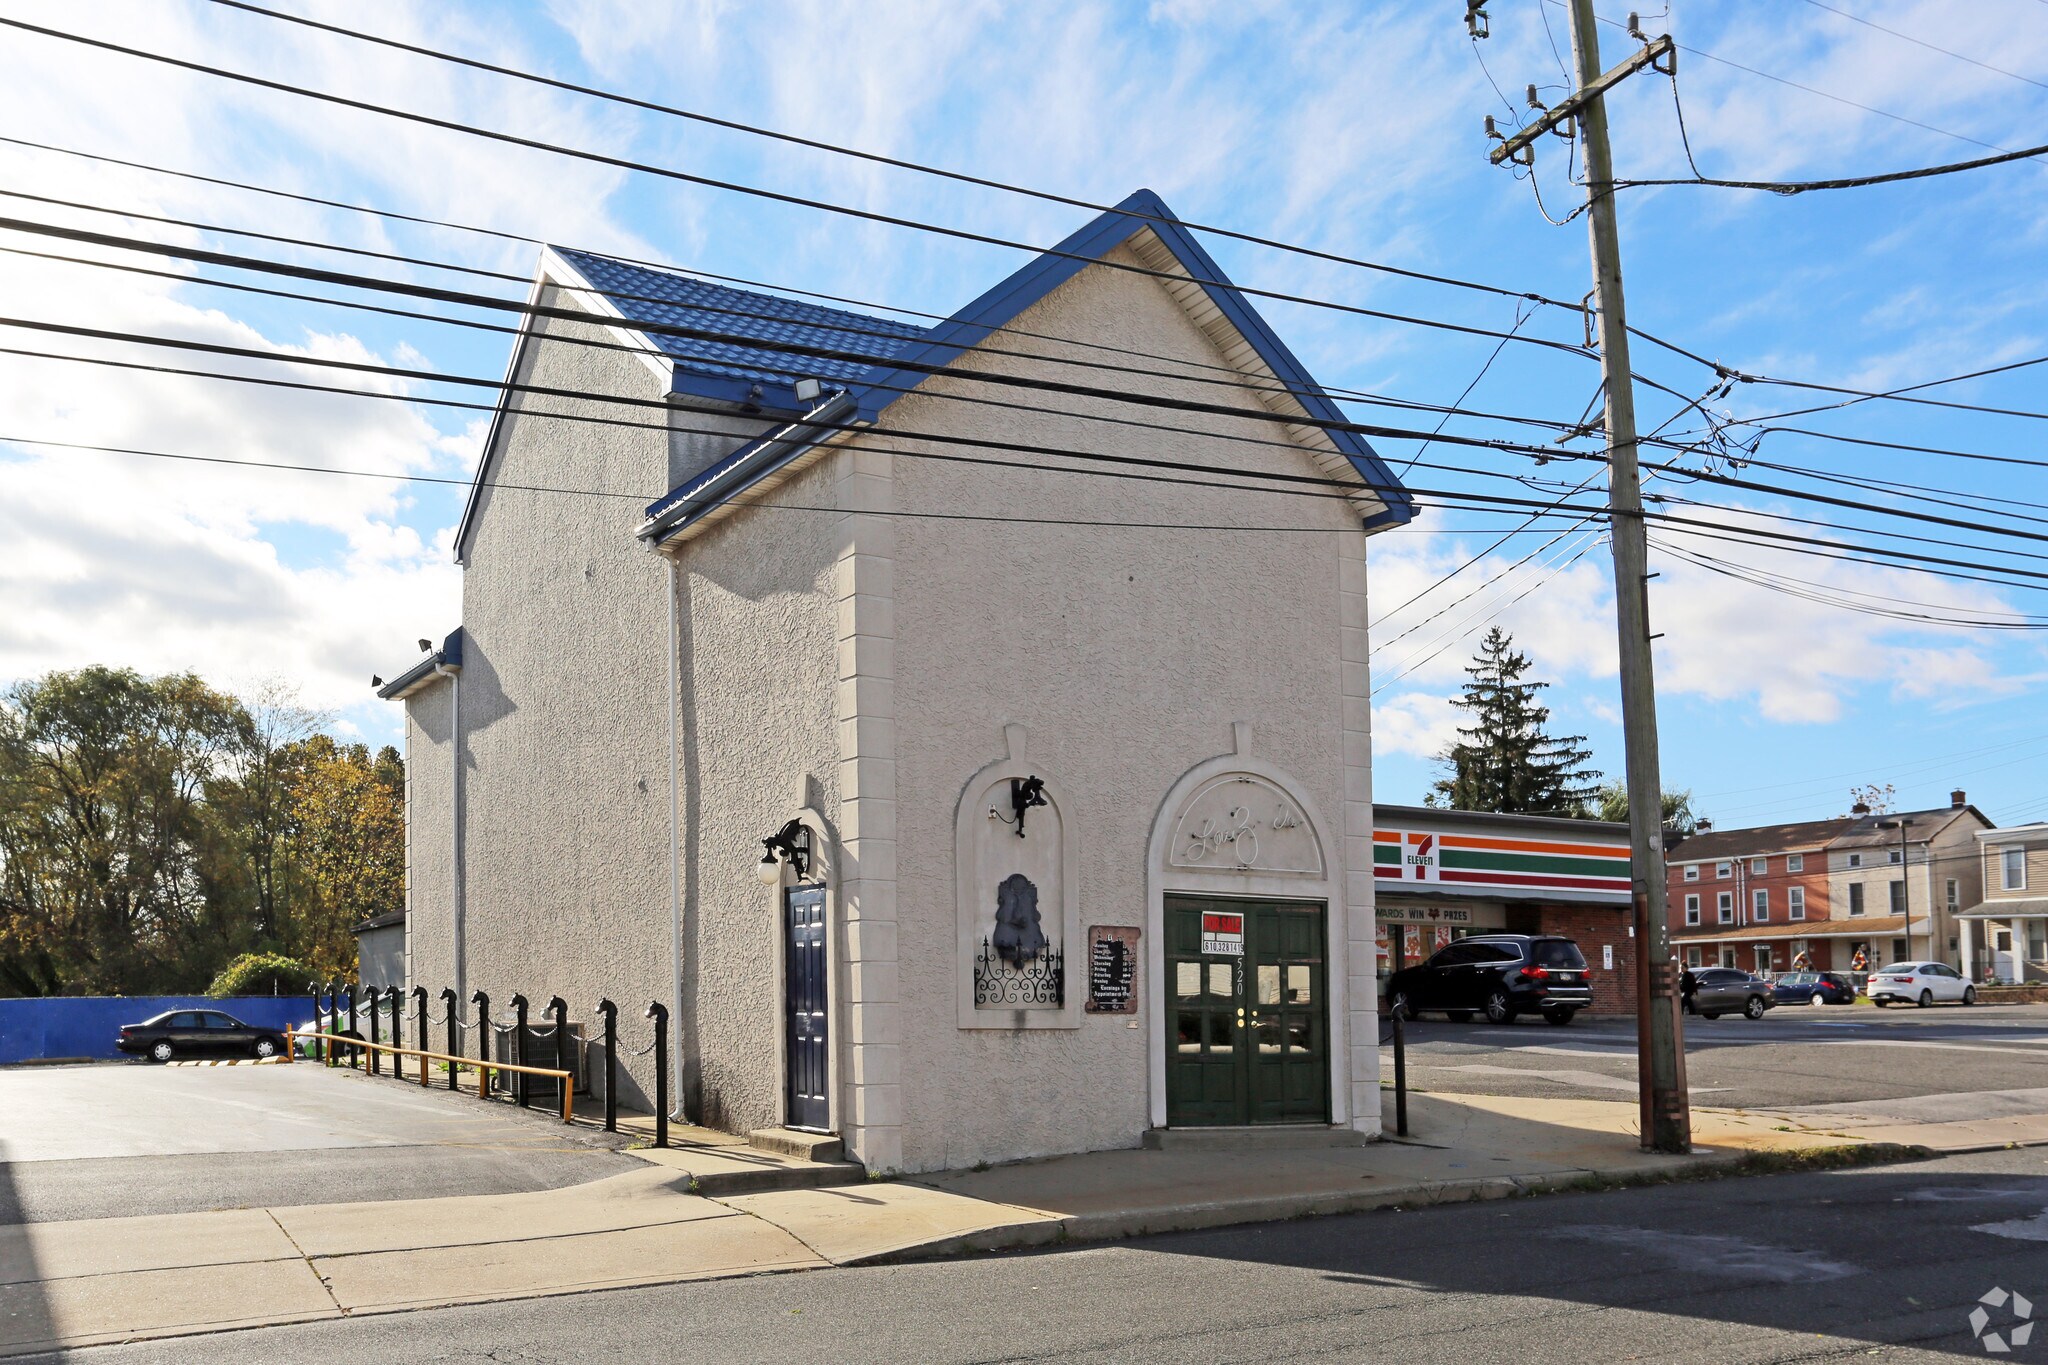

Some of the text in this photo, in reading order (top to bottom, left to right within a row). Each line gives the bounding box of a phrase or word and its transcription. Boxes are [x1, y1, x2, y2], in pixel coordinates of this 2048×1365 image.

[1416, 834, 1432, 880] 7
[1409, 908, 1424, 919] WIN
[1205, 915, 1241, 932] FOR SALE
